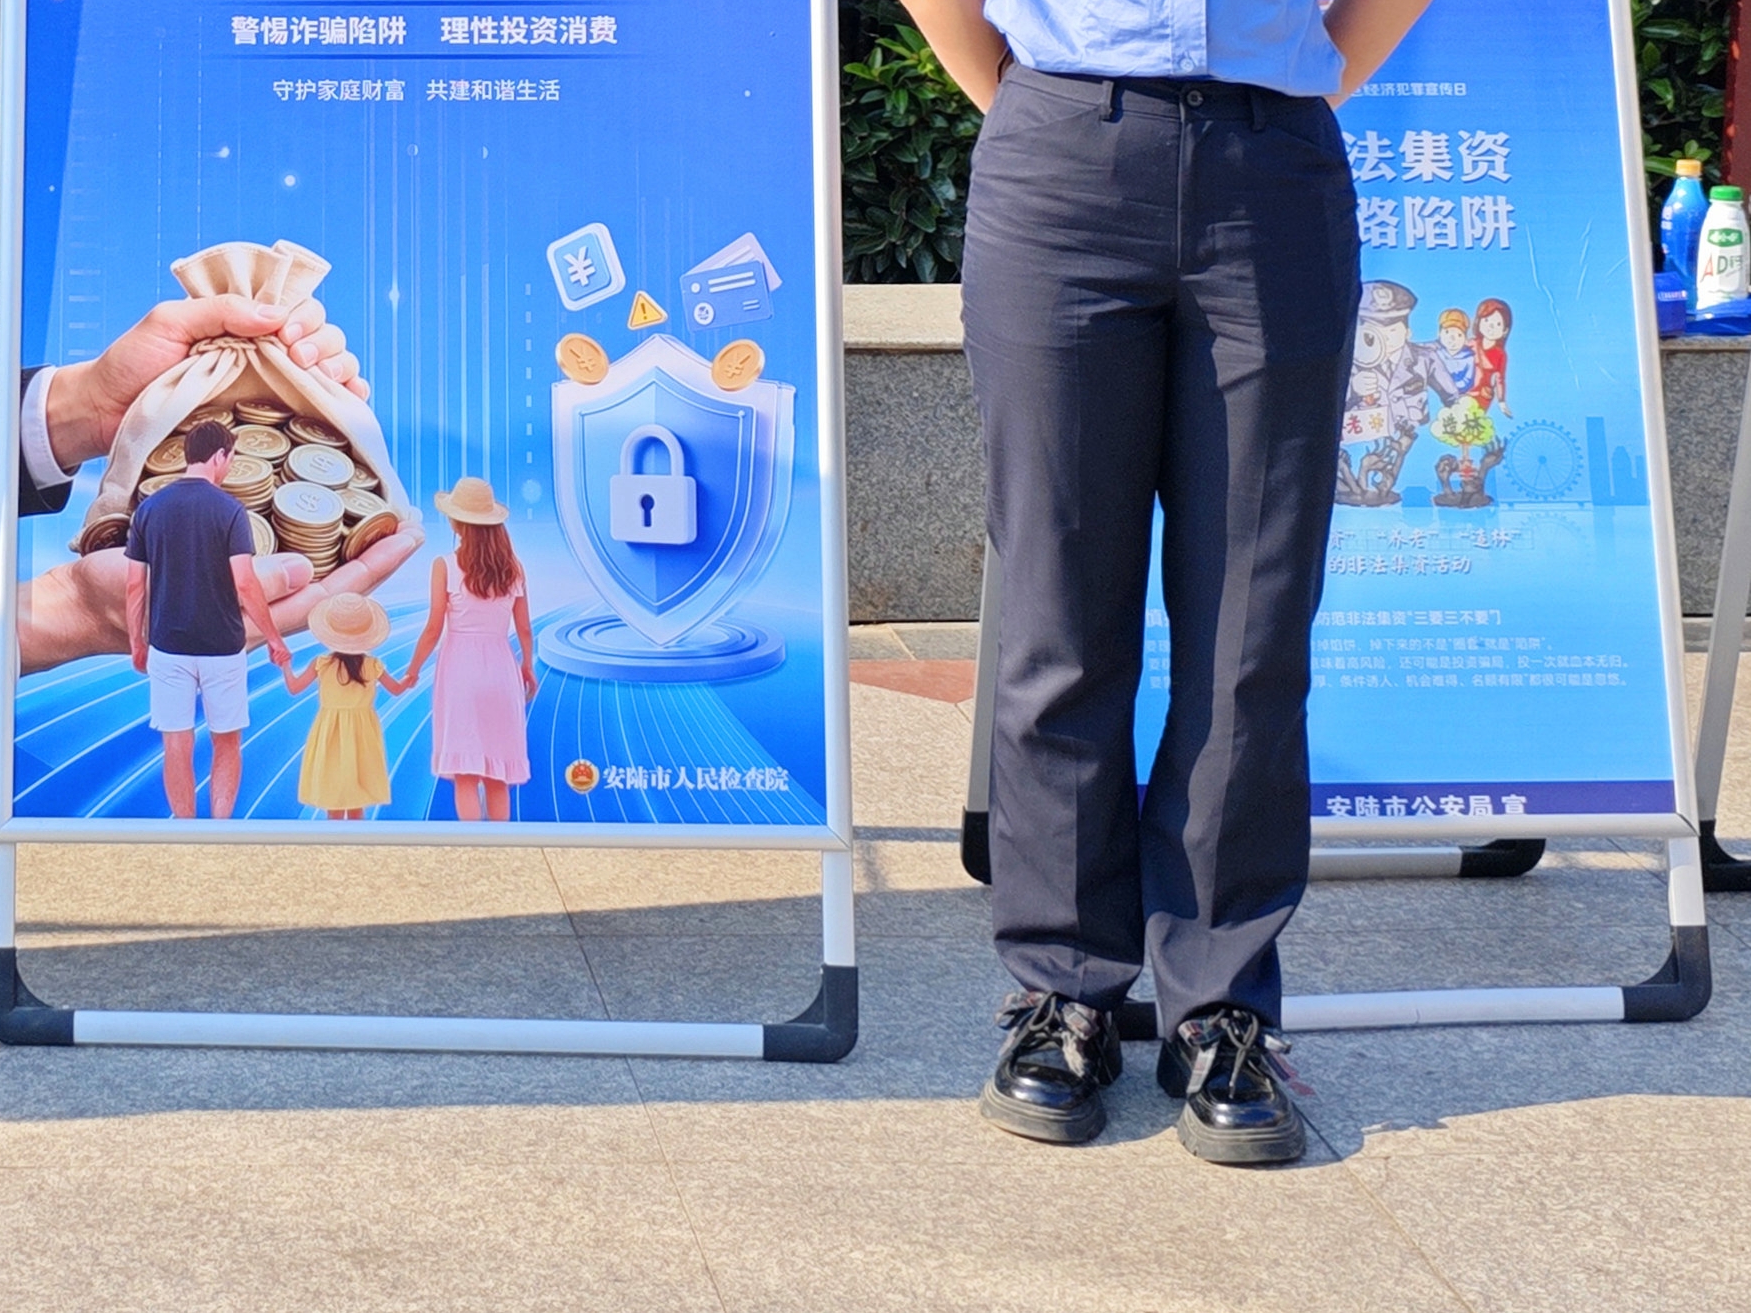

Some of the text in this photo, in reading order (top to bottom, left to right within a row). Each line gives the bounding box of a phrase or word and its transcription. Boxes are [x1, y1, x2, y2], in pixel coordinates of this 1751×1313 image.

[230, 15, 618, 46] 警惕诈骗陷阱 理性投资消费
[272, 78, 561, 102] 守护家庭财富 共建和谐生活
[1342, 129, 1513, 183] 法集资
[1441, 412, 1487, 436] 造林
[1328, 555, 1472, 575] 的非法集资活动
[1326, 793, 1528, 816] 安陆市公安局 宣
